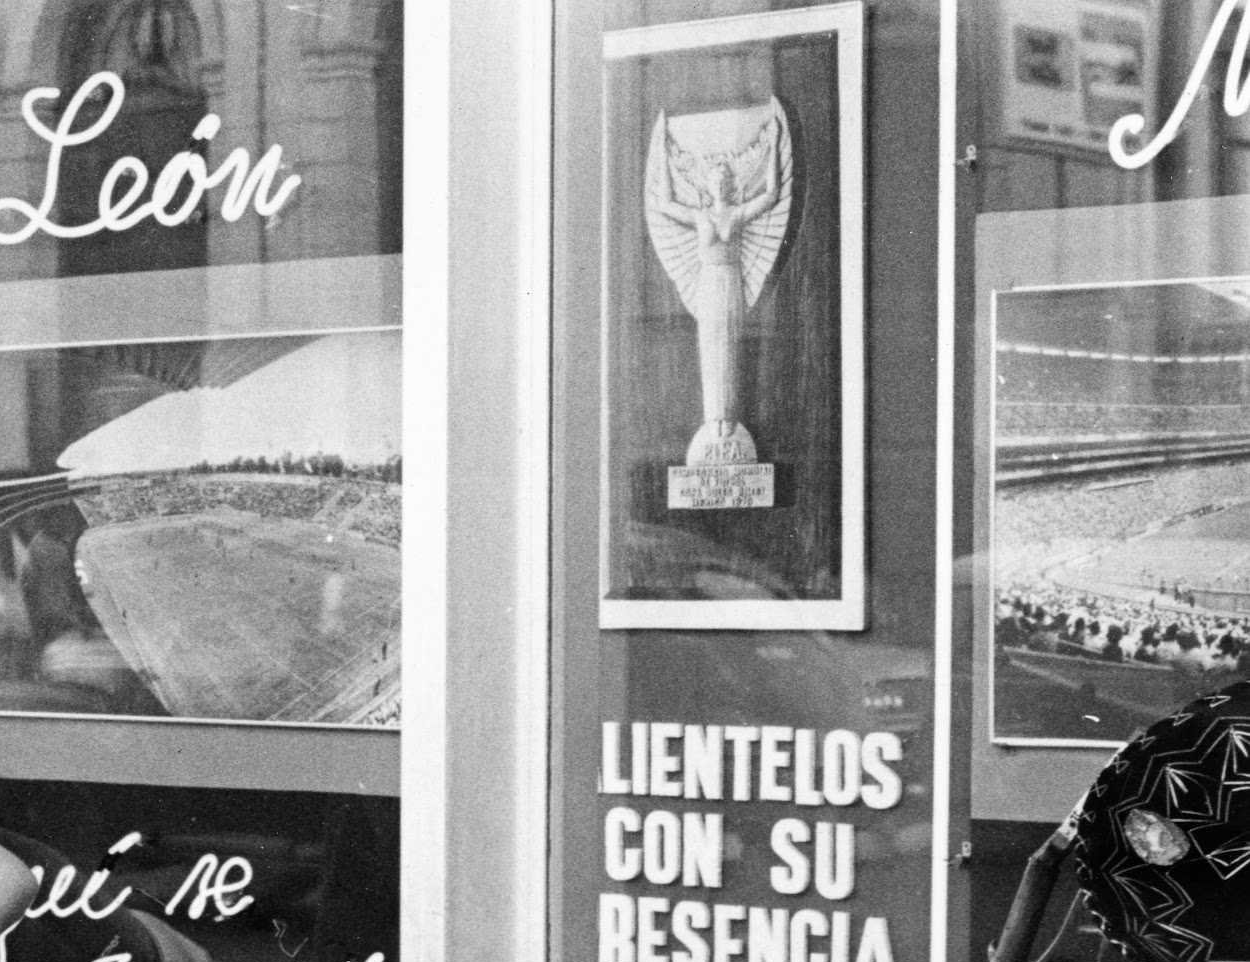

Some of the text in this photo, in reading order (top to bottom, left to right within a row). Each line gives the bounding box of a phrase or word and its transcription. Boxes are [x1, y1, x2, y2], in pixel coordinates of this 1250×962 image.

[599, 721, 903, 809] LIENTELOS
[165, 853, 254, 920] se
[605, 806, 856, 900] CON SU
